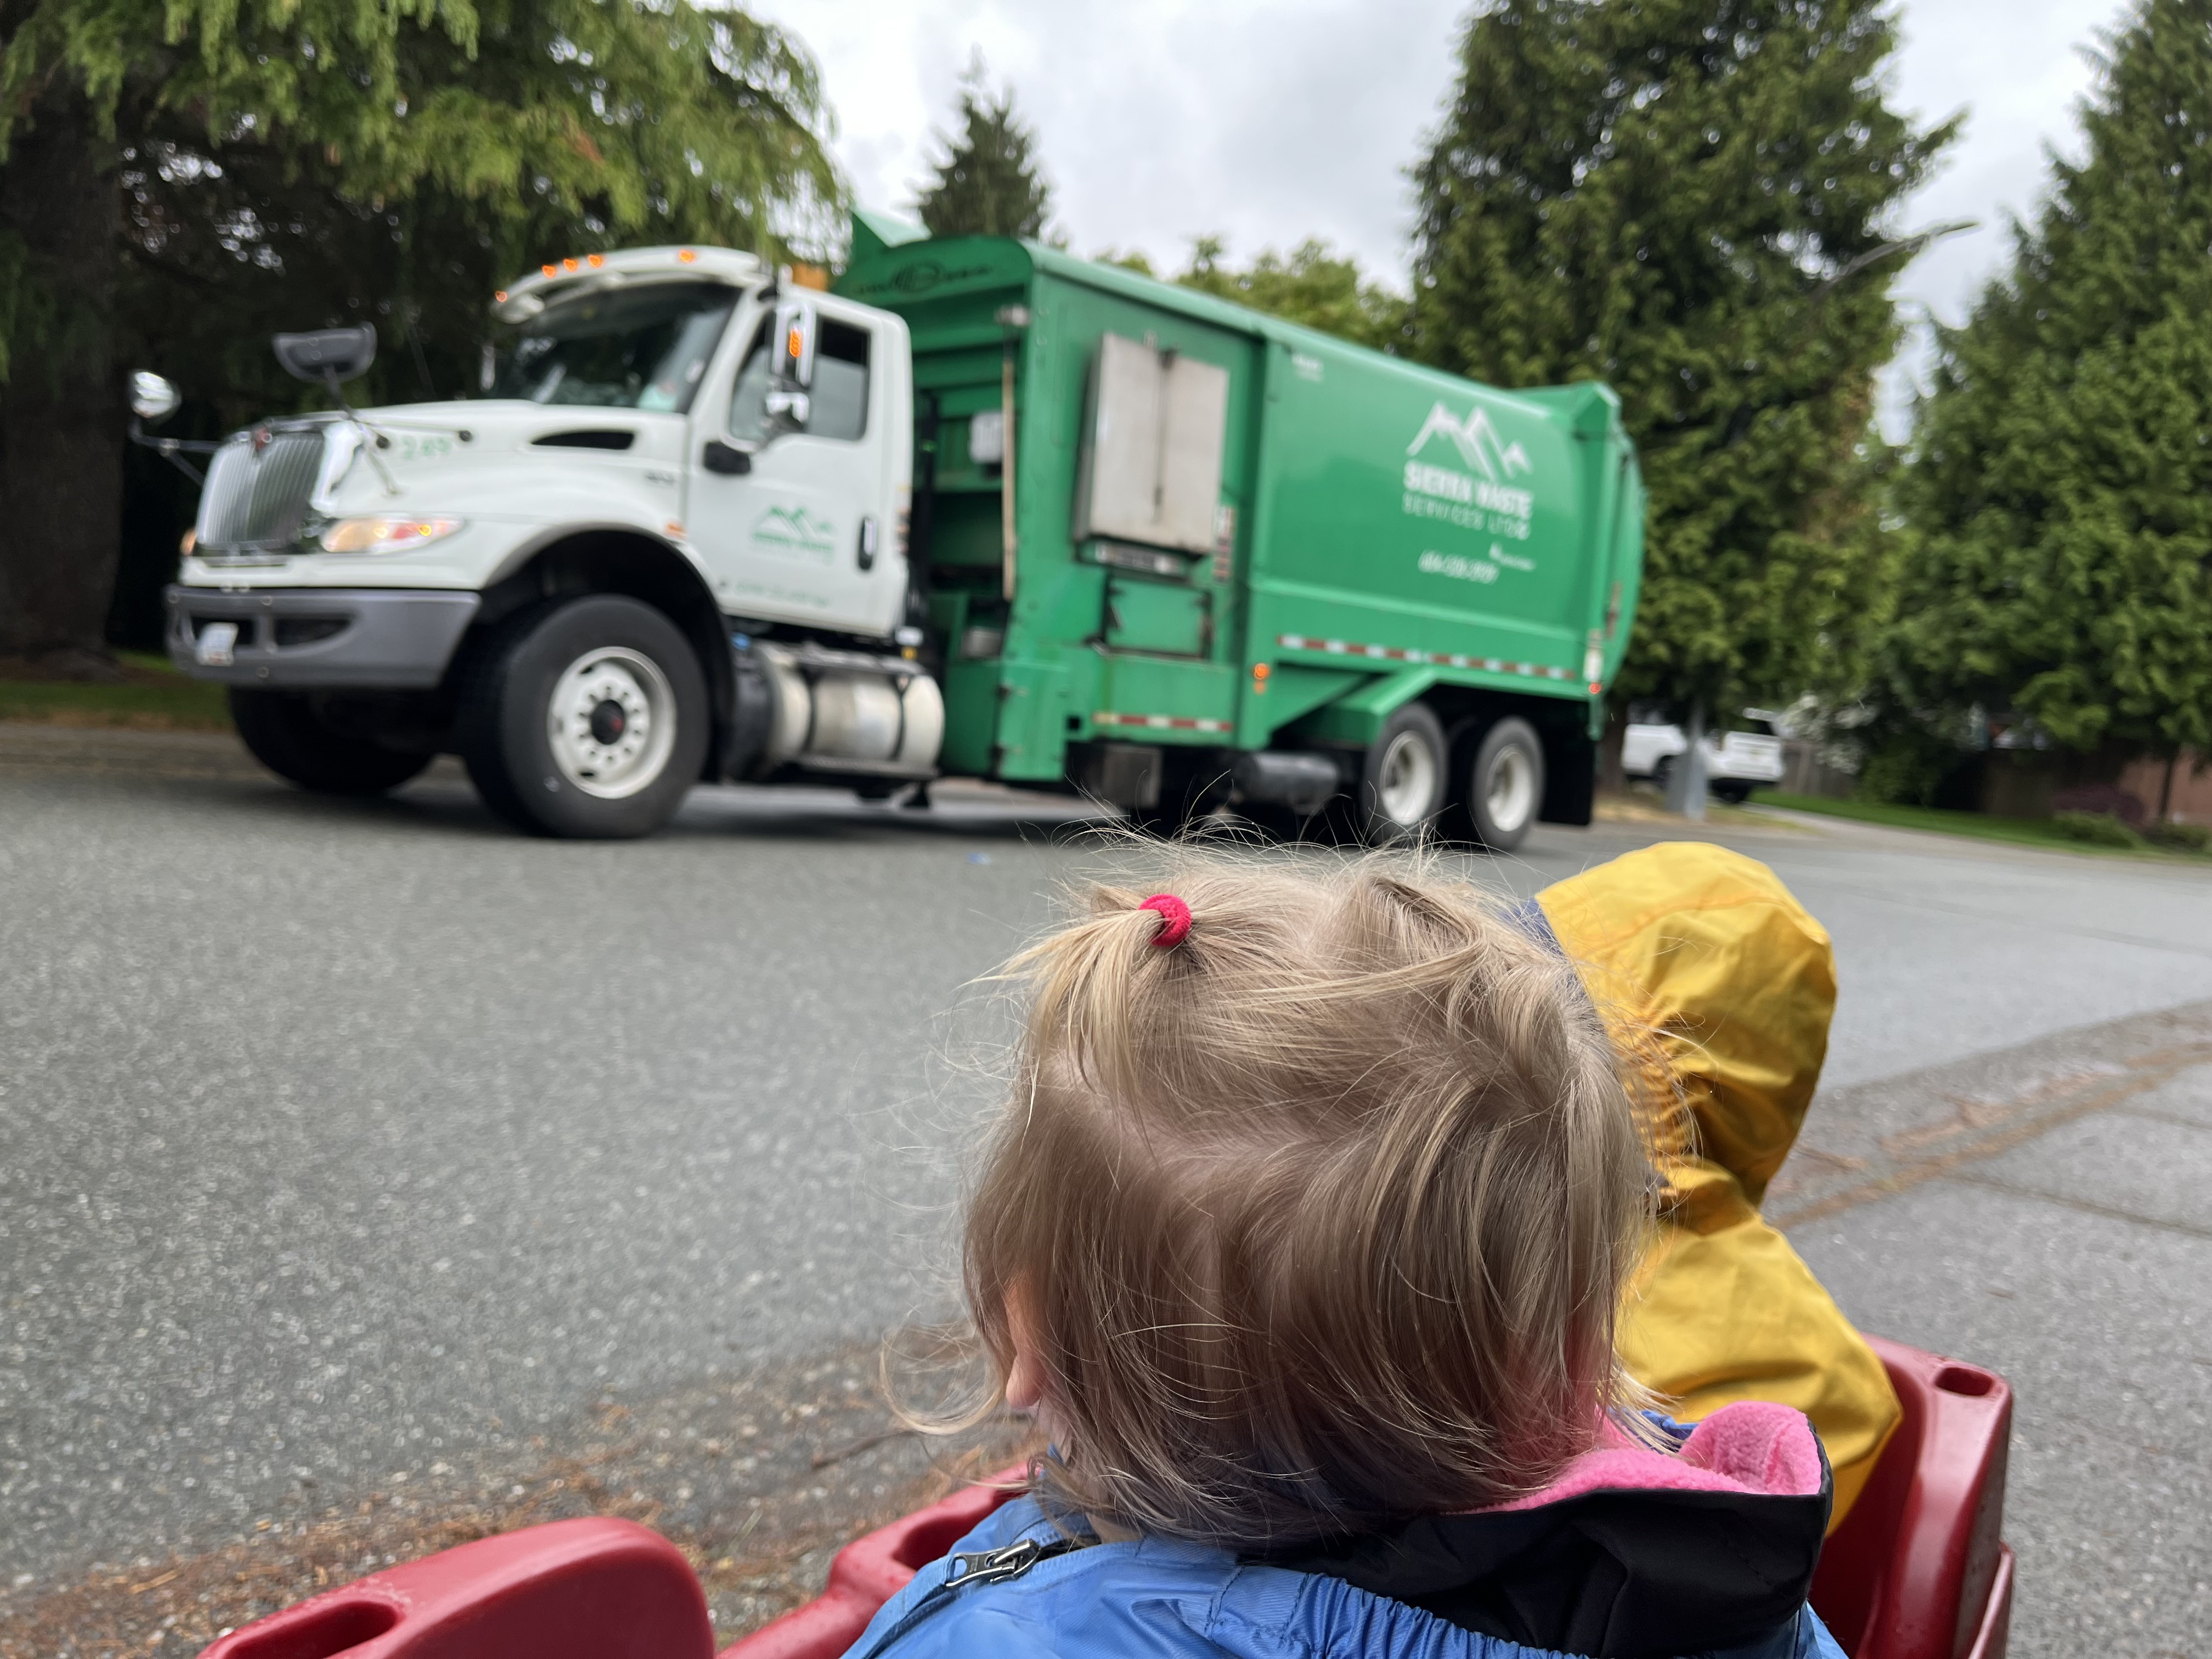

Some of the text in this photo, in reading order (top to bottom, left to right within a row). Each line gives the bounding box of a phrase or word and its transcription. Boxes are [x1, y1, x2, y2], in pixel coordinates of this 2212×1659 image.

[1401, 492, 1485, 530] SERVICES
[1403, 459, 1534, 520] SIERRA WASTE
